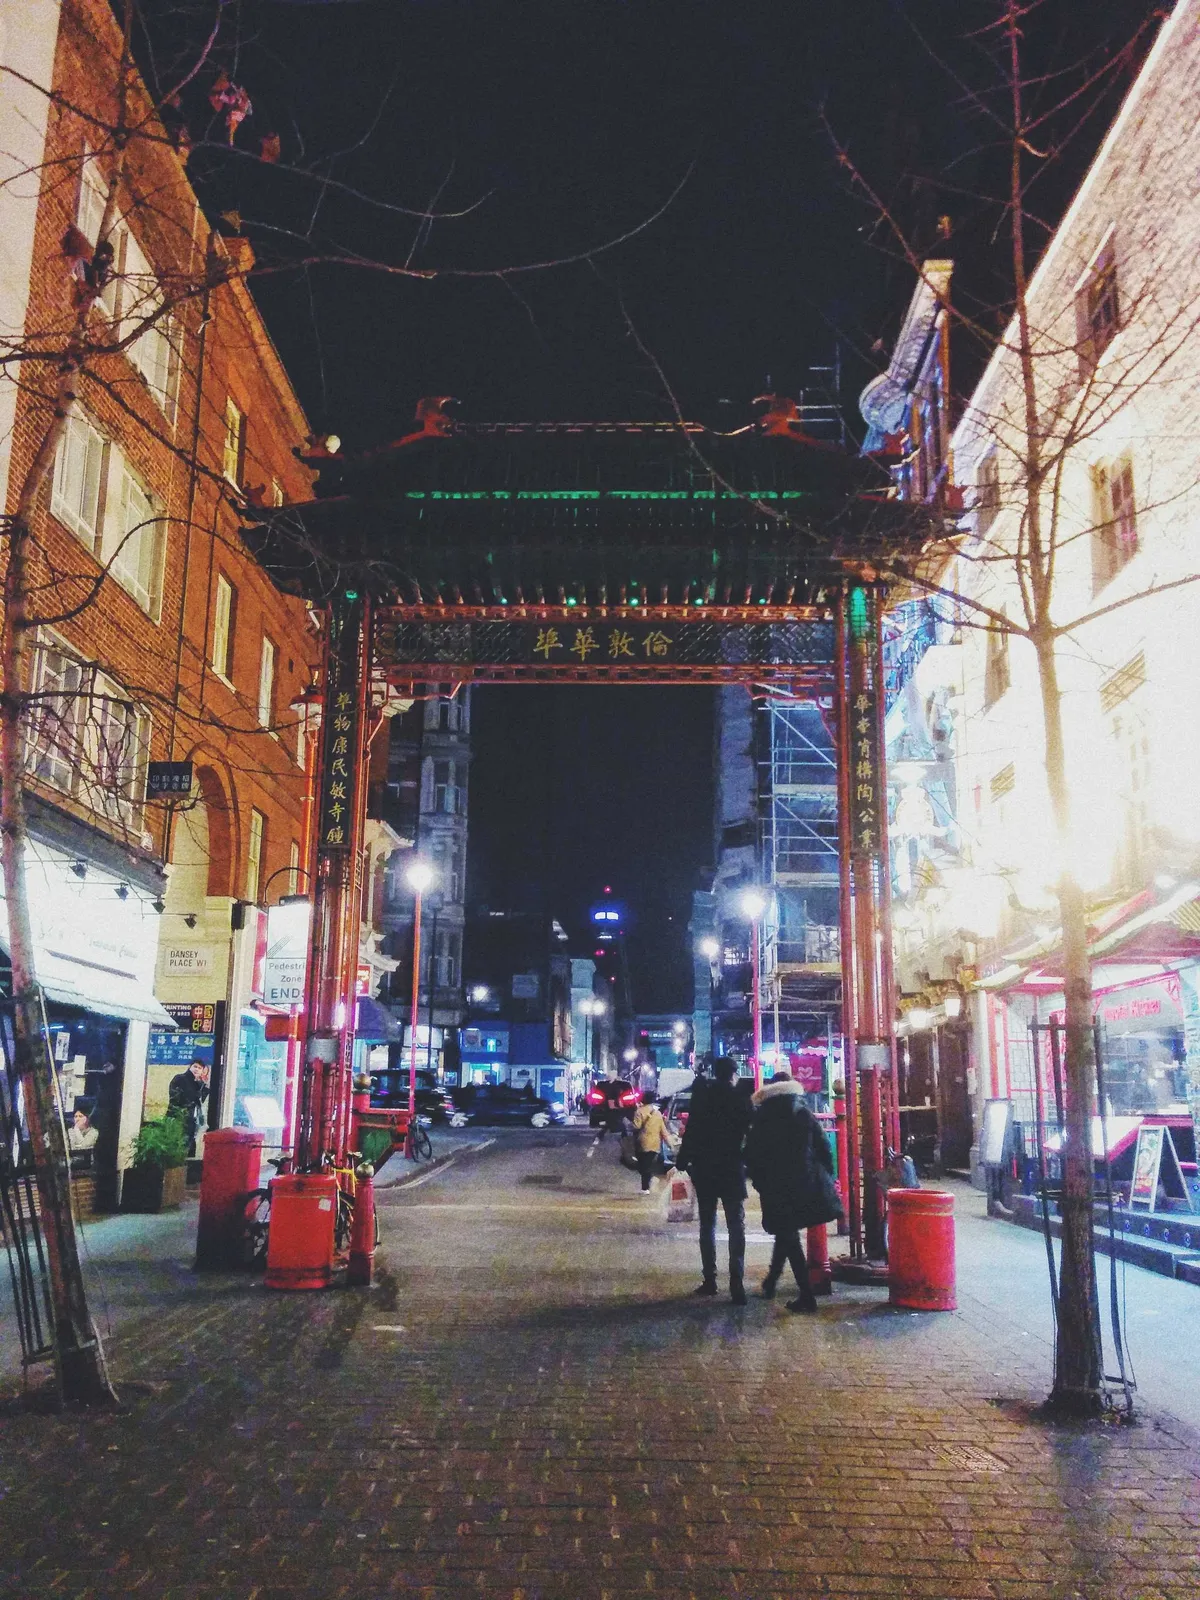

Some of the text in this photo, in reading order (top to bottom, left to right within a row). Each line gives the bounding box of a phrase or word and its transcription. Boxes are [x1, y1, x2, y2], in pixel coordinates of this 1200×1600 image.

[170, 950, 199, 959] DANSEY
[169, 959, 207, 967] PLACE W1
[268, 962, 305, 970] Pedestri
[280, 974, 302, 983] Zone
